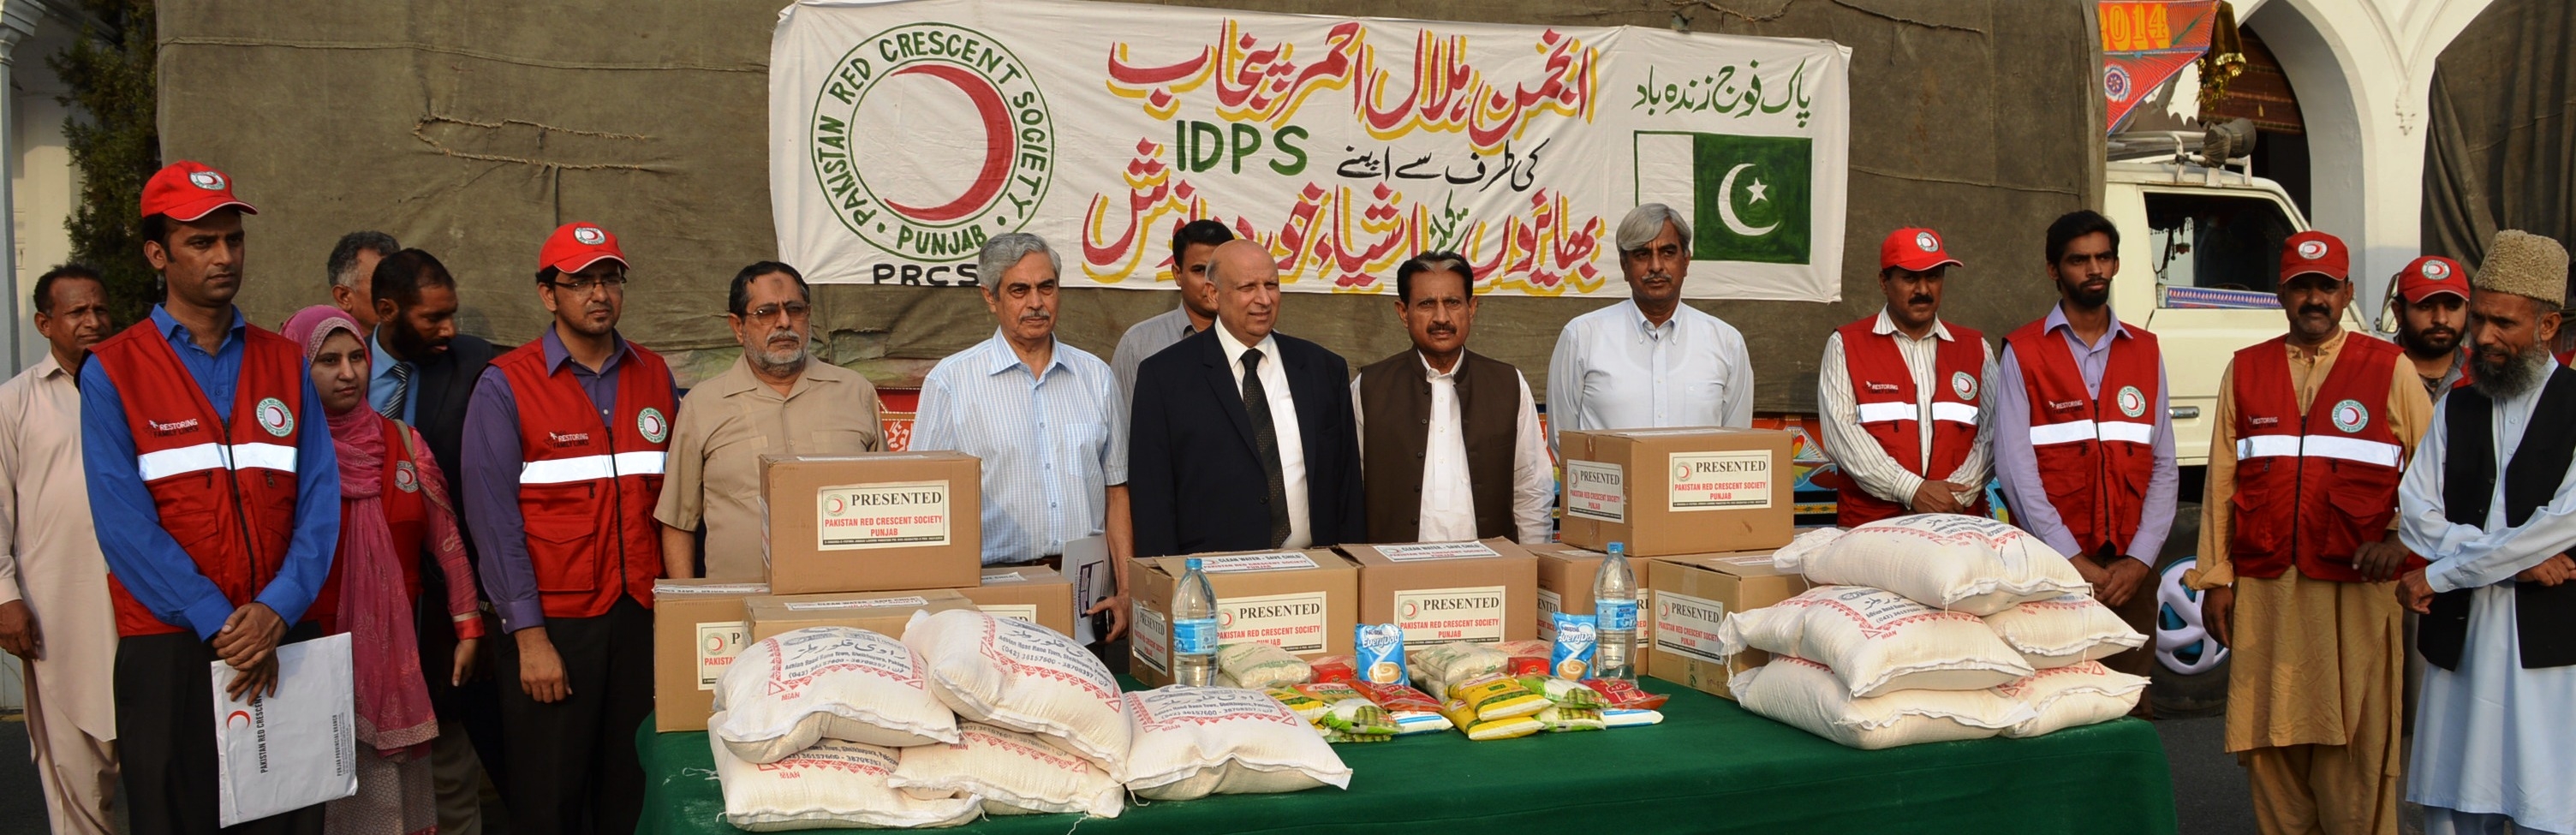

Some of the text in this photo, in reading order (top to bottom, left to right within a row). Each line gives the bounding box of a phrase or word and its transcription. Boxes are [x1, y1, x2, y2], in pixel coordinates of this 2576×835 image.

[1107, 17, 1593, 150] انجمن ہلال احمر پنجاب
[1631, 57, 1811, 128] پاک فوج زندہ باد
[818, 30, 1048, 227] PAKISTAN RED CRESCENT SOCIETY
[1176, 120, 1550, 193] کی طرف سے اپنے IDPS
[897, 224, 987, 256] PUNJAB
[159, 419, 198, 431] RESTORING
[558, 432, 589, 442] RESTORING
[1696, 461, 1766, 473] PRESENTED
[1675, 481, 1766, 492] PAKISTAN RED CRESCENT SOCIETY
[851, 492, 942, 506] PRESENTED
[825, 515, 942, 528] PAKISTAN RED CRESCENT SOCIETY
[870, 528, 898, 537] PUNJAB
[1423, 597, 1500, 611] PRESENTED
[1240, 603, 1321, 619] PRESENTED
[1672, 602, 1720, 623] PRESENTED
[1443, 619, 1474, 628] CRESCENT
[1475, 618, 1500, 627] SOCIETY
[1247, 629, 1260, 637] RED
[1261, 627, 1293, 636] CRESCENT
[1295, 625, 1321, 635] SOCIETY
[1659, 621, 1675, 632] PAKISTAN
[1684, 627, 1702, 639] CRESCENT
[1881, 630, 1898, 641] MIAN
[1363, 635, 1400, 648] EveryDay
[1558, 633, 1596, 644] EveryDay
[1680, 636, 1696, 647] PUNJAB
[1002, 645, 1021, 659] (042)
[705, 657, 736, 665] PAKISTA
[788, 671, 808, 679] (042)
[781, 691, 801, 701] MIAN
[259, 743, 268, 774] PAKISTAN
